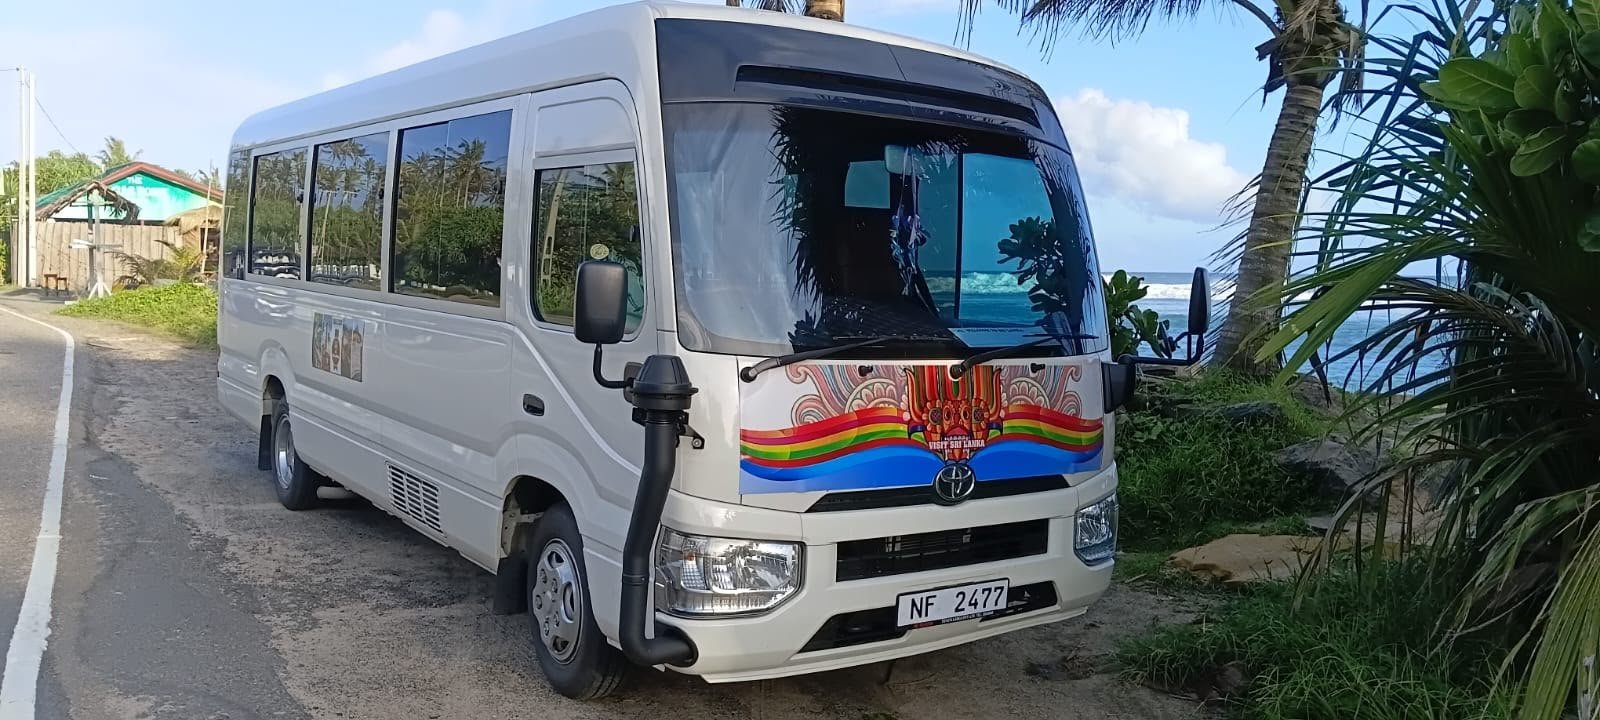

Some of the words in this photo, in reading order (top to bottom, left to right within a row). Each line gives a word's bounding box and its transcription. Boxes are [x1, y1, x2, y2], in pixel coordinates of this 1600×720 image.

[929, 441, 948, 450] VISIT
[950, 440, 962, 449] SRI
[963, 439, 985, 448] LANKA
[910, 594, 937, 619] NF
[954, 586, 1004, 613] 2477
